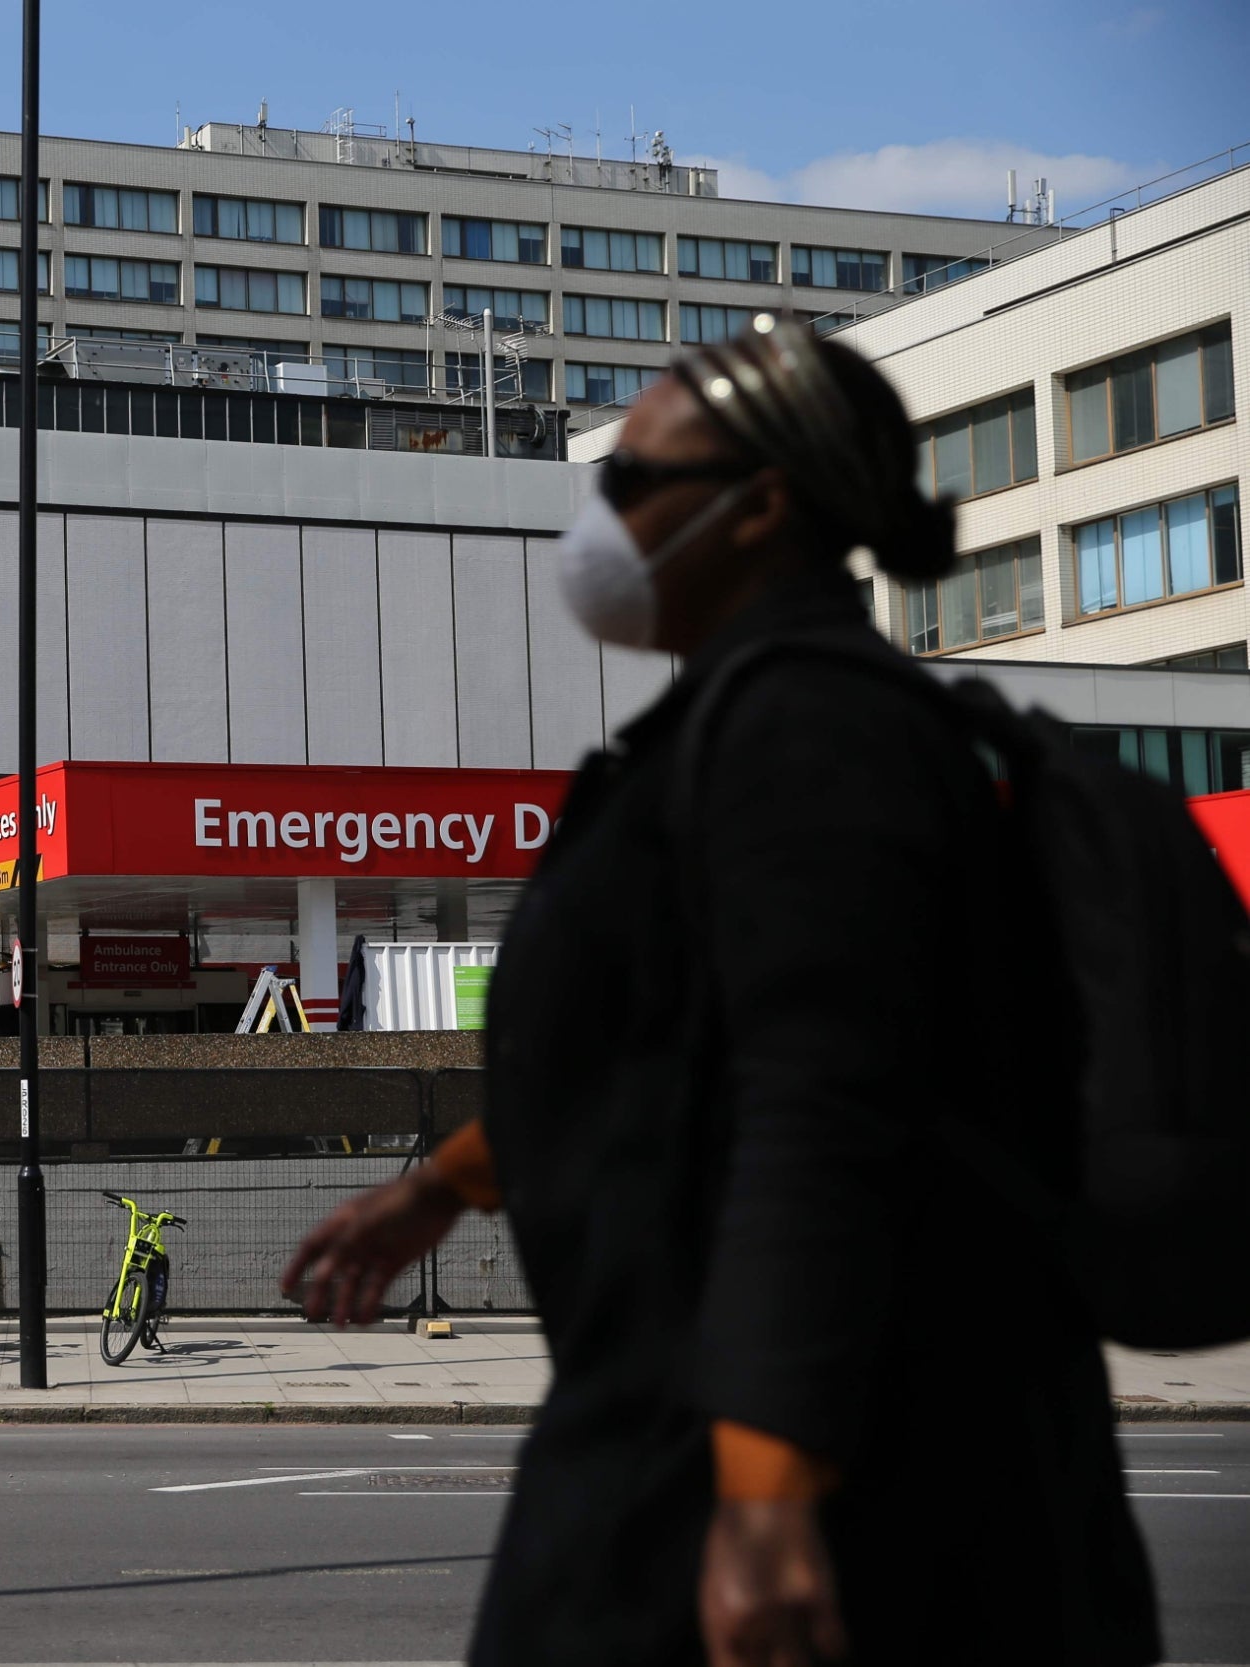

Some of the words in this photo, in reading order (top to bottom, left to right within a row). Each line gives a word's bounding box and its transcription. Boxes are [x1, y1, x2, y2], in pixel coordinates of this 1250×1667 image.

[36, 793, 57, 836] nly
[195, 798, 494, 863] Emergency
[514, 803, 562, 850] D
[93, 944, 162, 957] Ambulance
[94, 961, 147, 973] Entrance
[150, 961, 179, 976] Only
